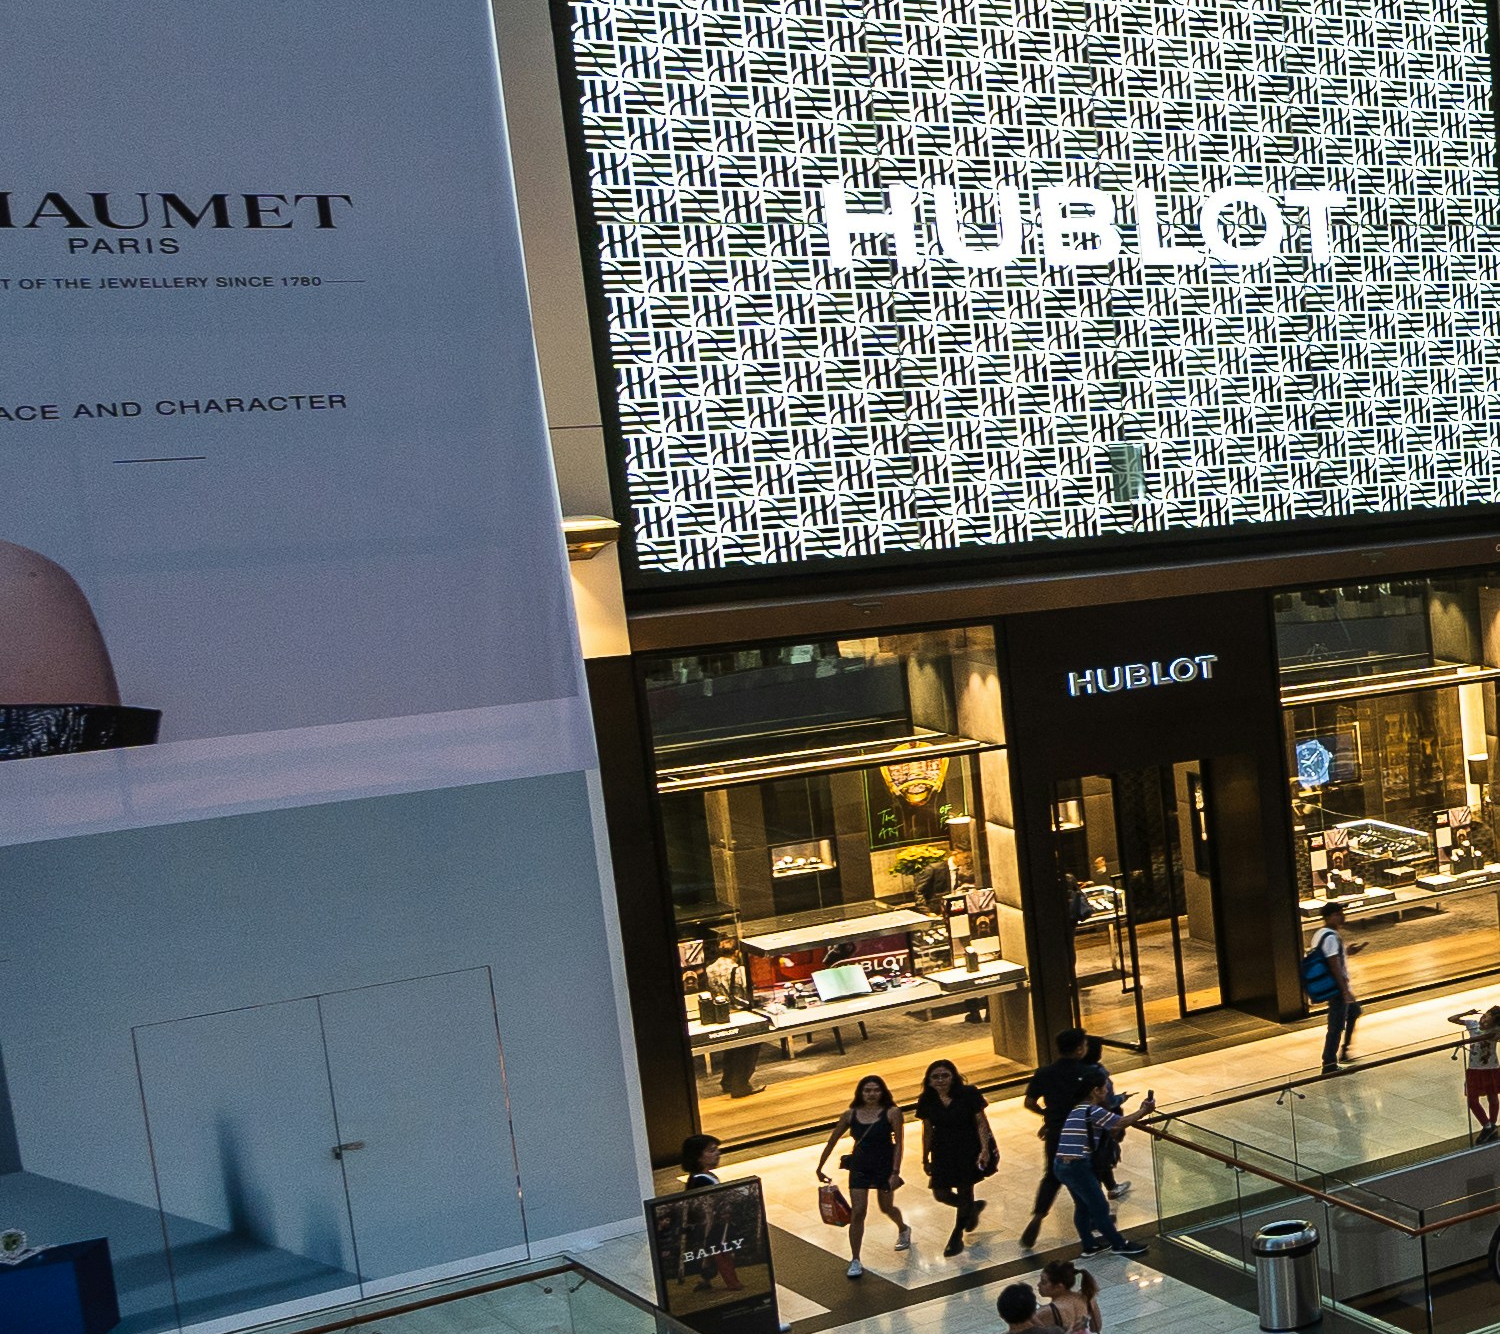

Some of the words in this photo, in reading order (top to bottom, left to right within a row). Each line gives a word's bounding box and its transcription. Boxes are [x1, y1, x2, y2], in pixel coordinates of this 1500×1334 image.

[822, 179, 1349, 269] HUBLOT
[68, 237, 180, 254] PARIS
[19, 278, 46, 289] OF
[53, 278, 91, 289] THE
[99, 276, 208, 289] JEWELLERY
[216, 276, 274, 288] SINCE
[281, 276, 322, 287] 1780
[72, 402, 142, 419] AND
[155, 394, 347, 415] CHARACTER
[1067, 653, 1219, 697] HUBLOT
[684, 1238, 745, 1263] BALLY
